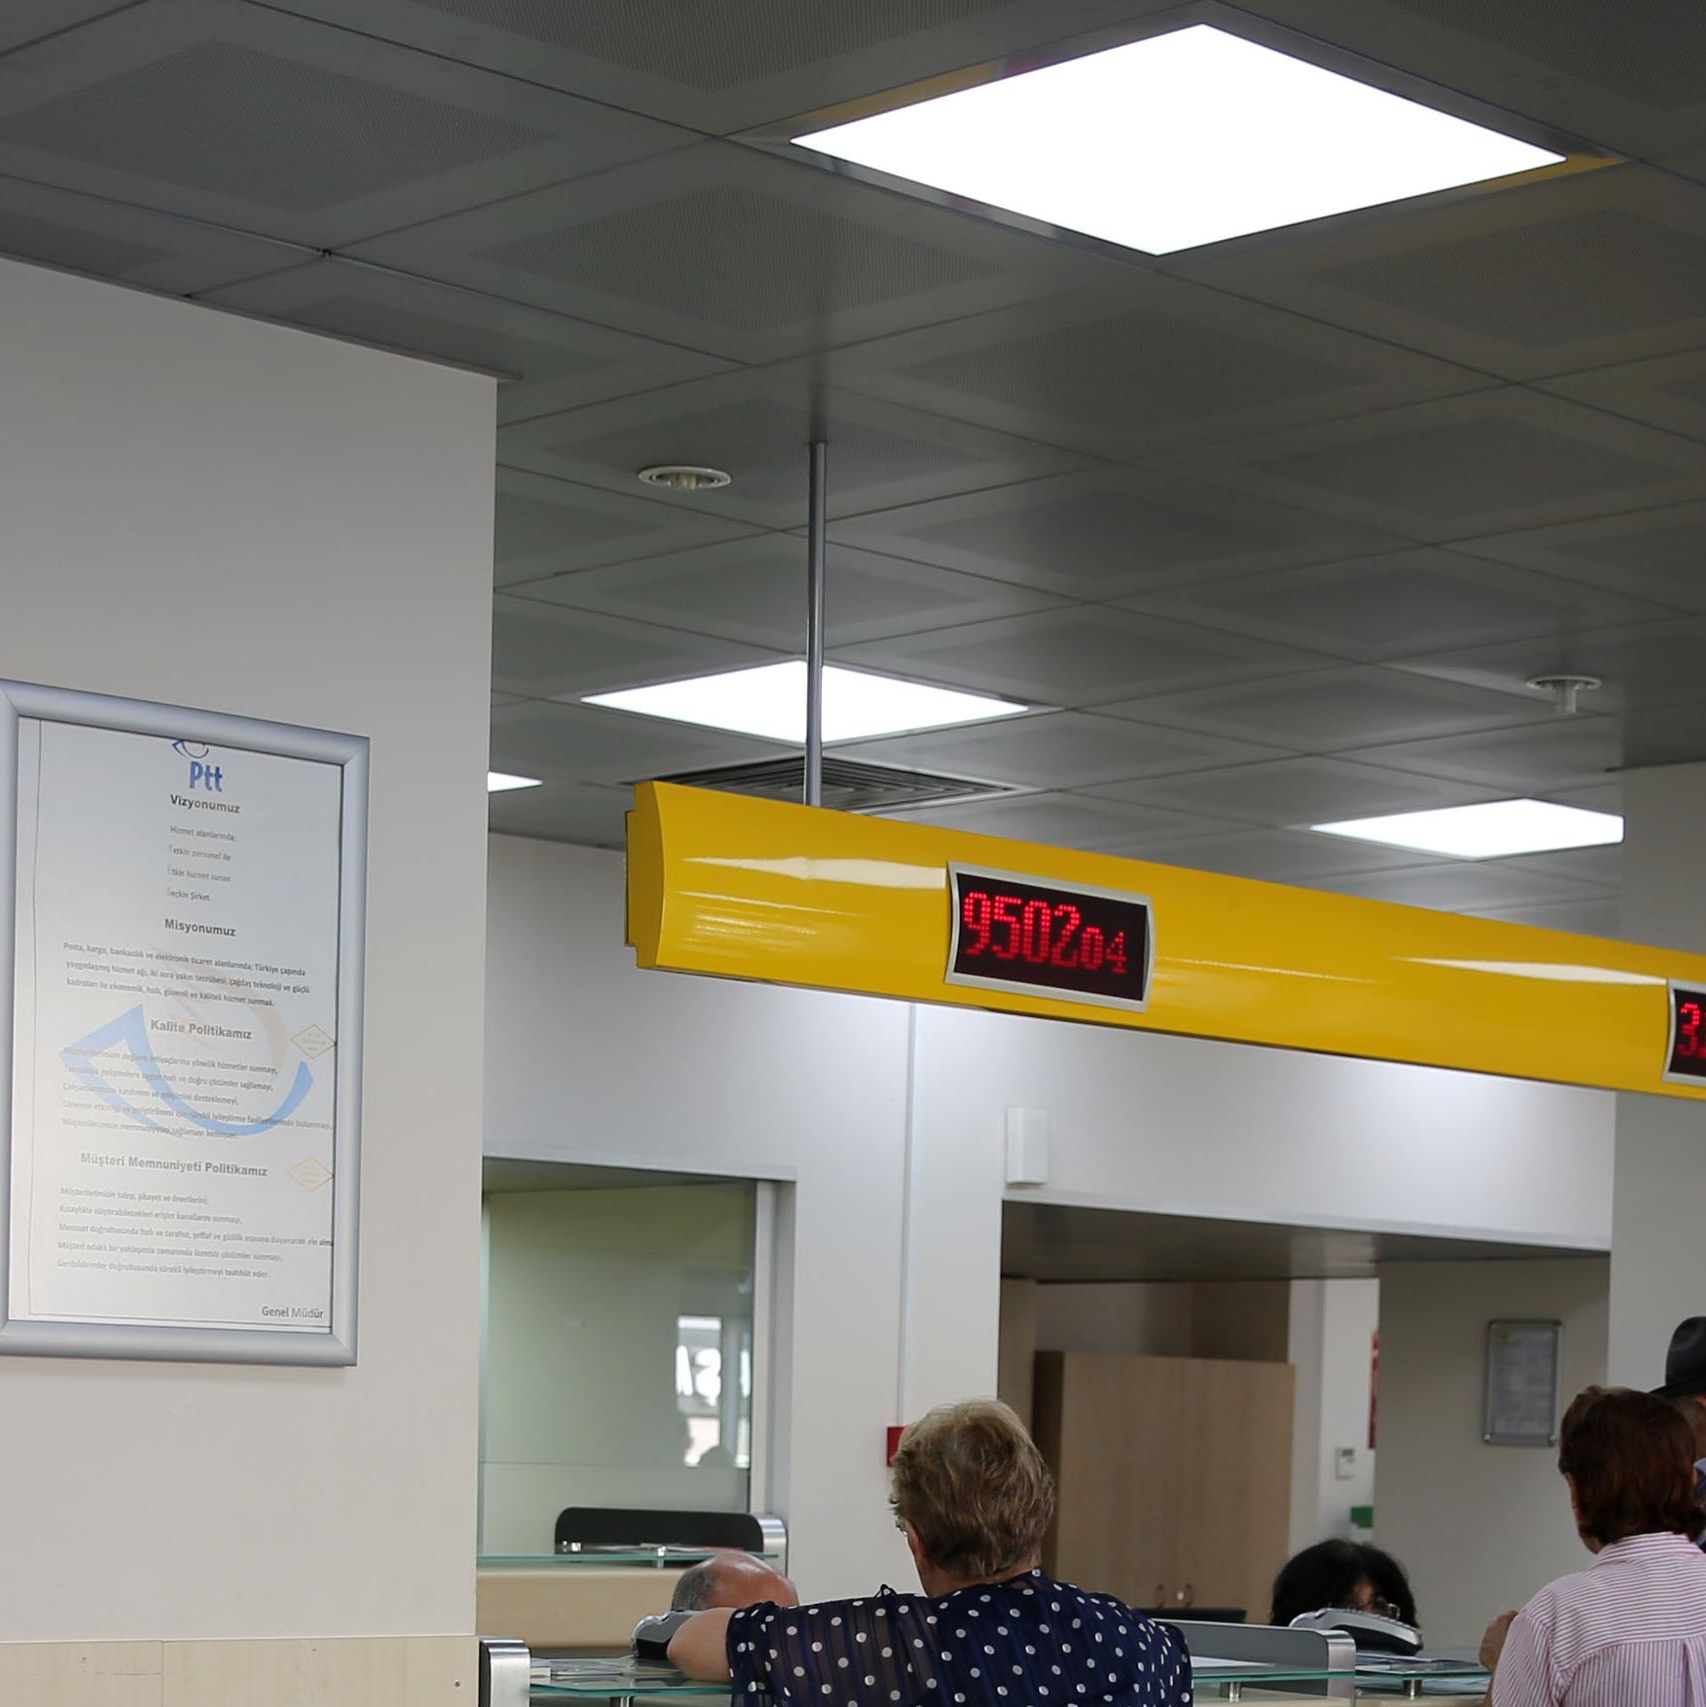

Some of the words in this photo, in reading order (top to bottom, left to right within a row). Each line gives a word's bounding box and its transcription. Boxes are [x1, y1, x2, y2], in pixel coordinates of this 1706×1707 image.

[189, 761, 223, 792] Ptt
[170, 794, 241, 814] Vizyonumuz
[164, 918, 237, 937] Misyonumuz
[253, 961, 278, 973] Türkiye
[151, 1019, 185, 1033] Kalite
[189, 1023, 252, 1040] Politikamız
[80, 1153, 125, 1167] Müşteri
[129, 1156, 202, 1173] Memnuniyeti
[205, 1162, 268, 1177] Politikamız
[261, 1306, 289, 1317] Genel
[292, 1307, 325, 1319] Müdür
